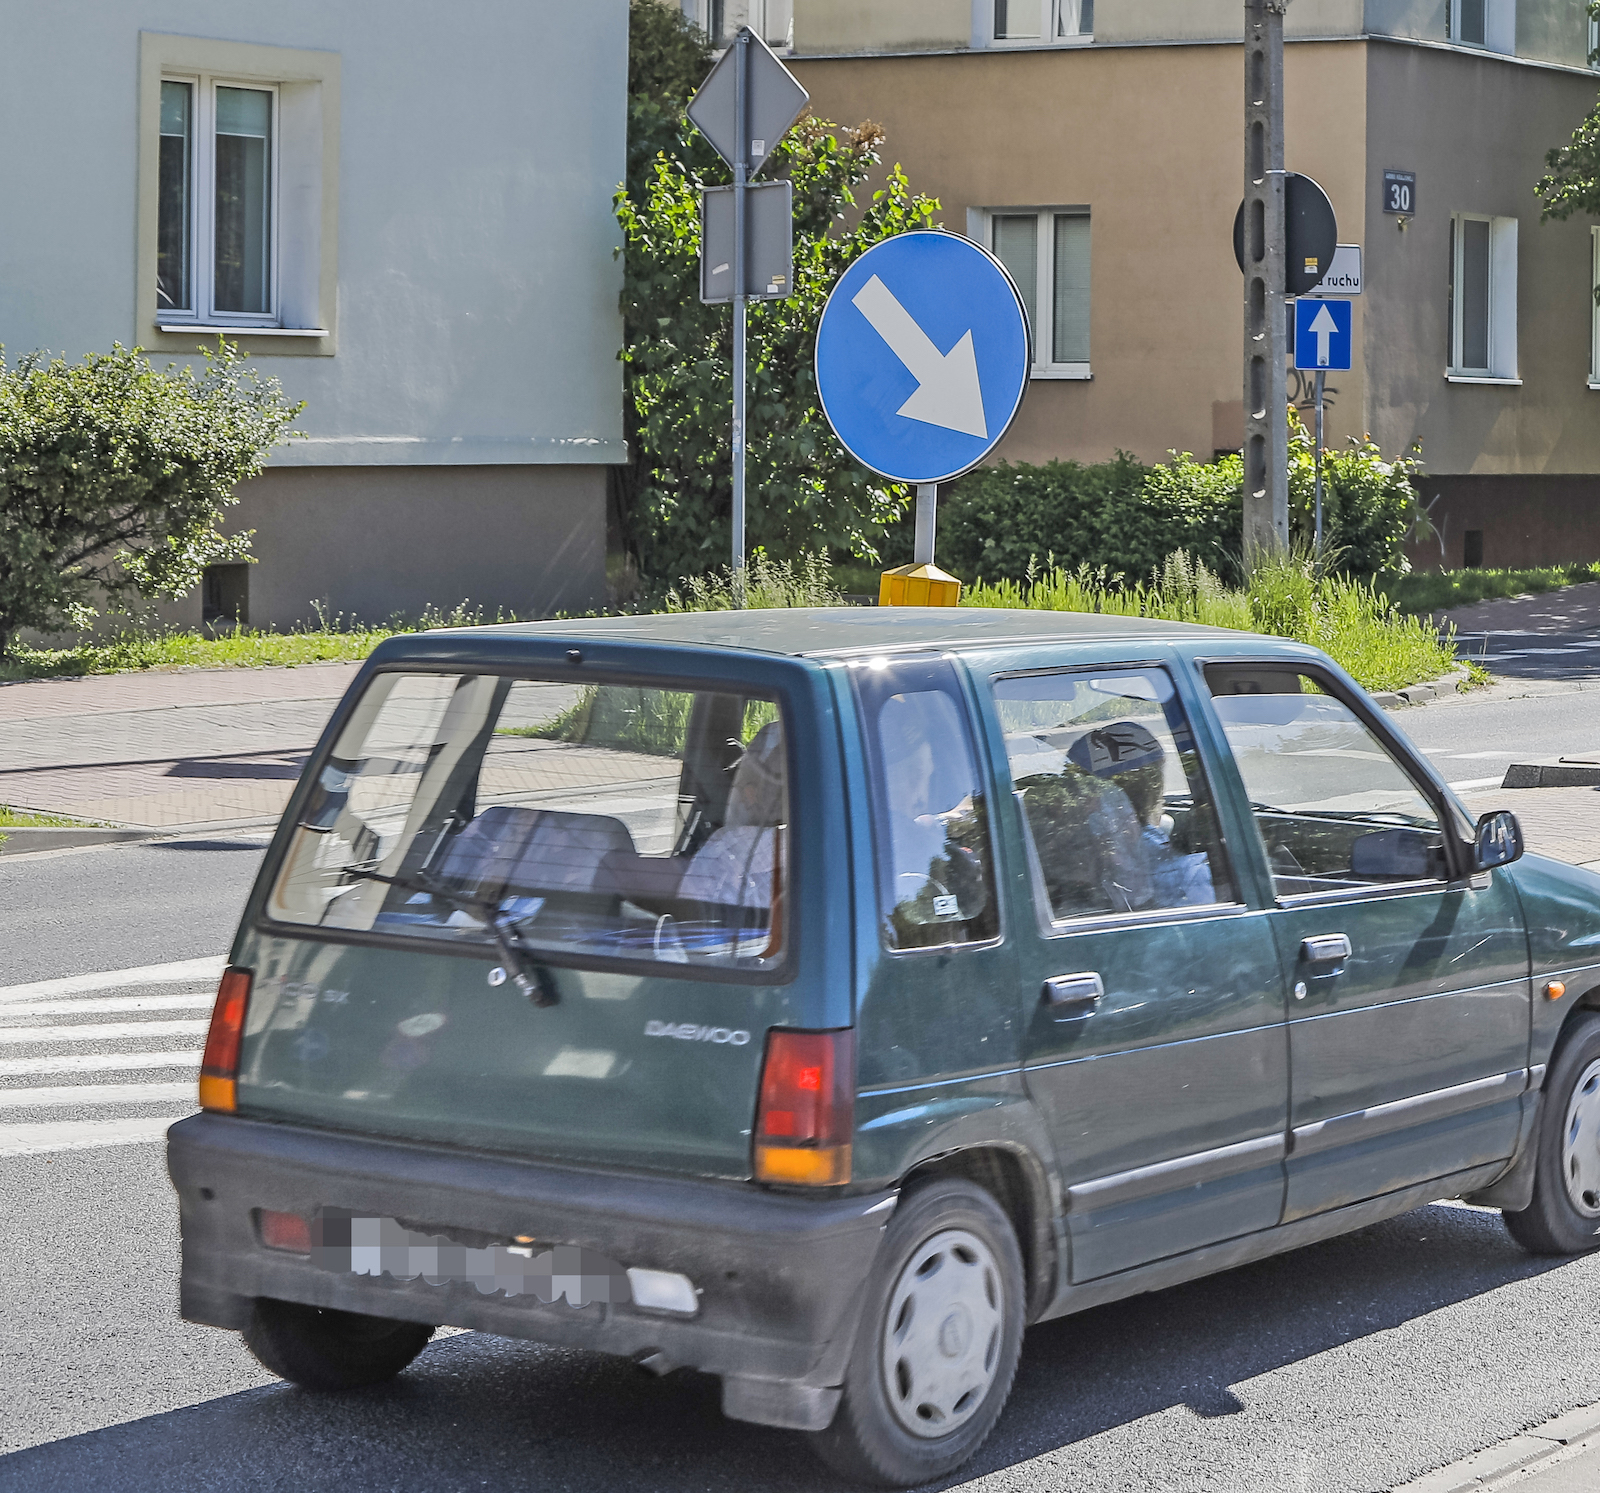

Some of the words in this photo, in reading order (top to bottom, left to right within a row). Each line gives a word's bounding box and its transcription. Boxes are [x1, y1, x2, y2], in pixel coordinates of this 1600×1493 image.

[1391, 184, 1410, 210] 30
[1327, 274, 1359, 286] ruchu
[644, 1020, 751, 1046] DAEWOO
